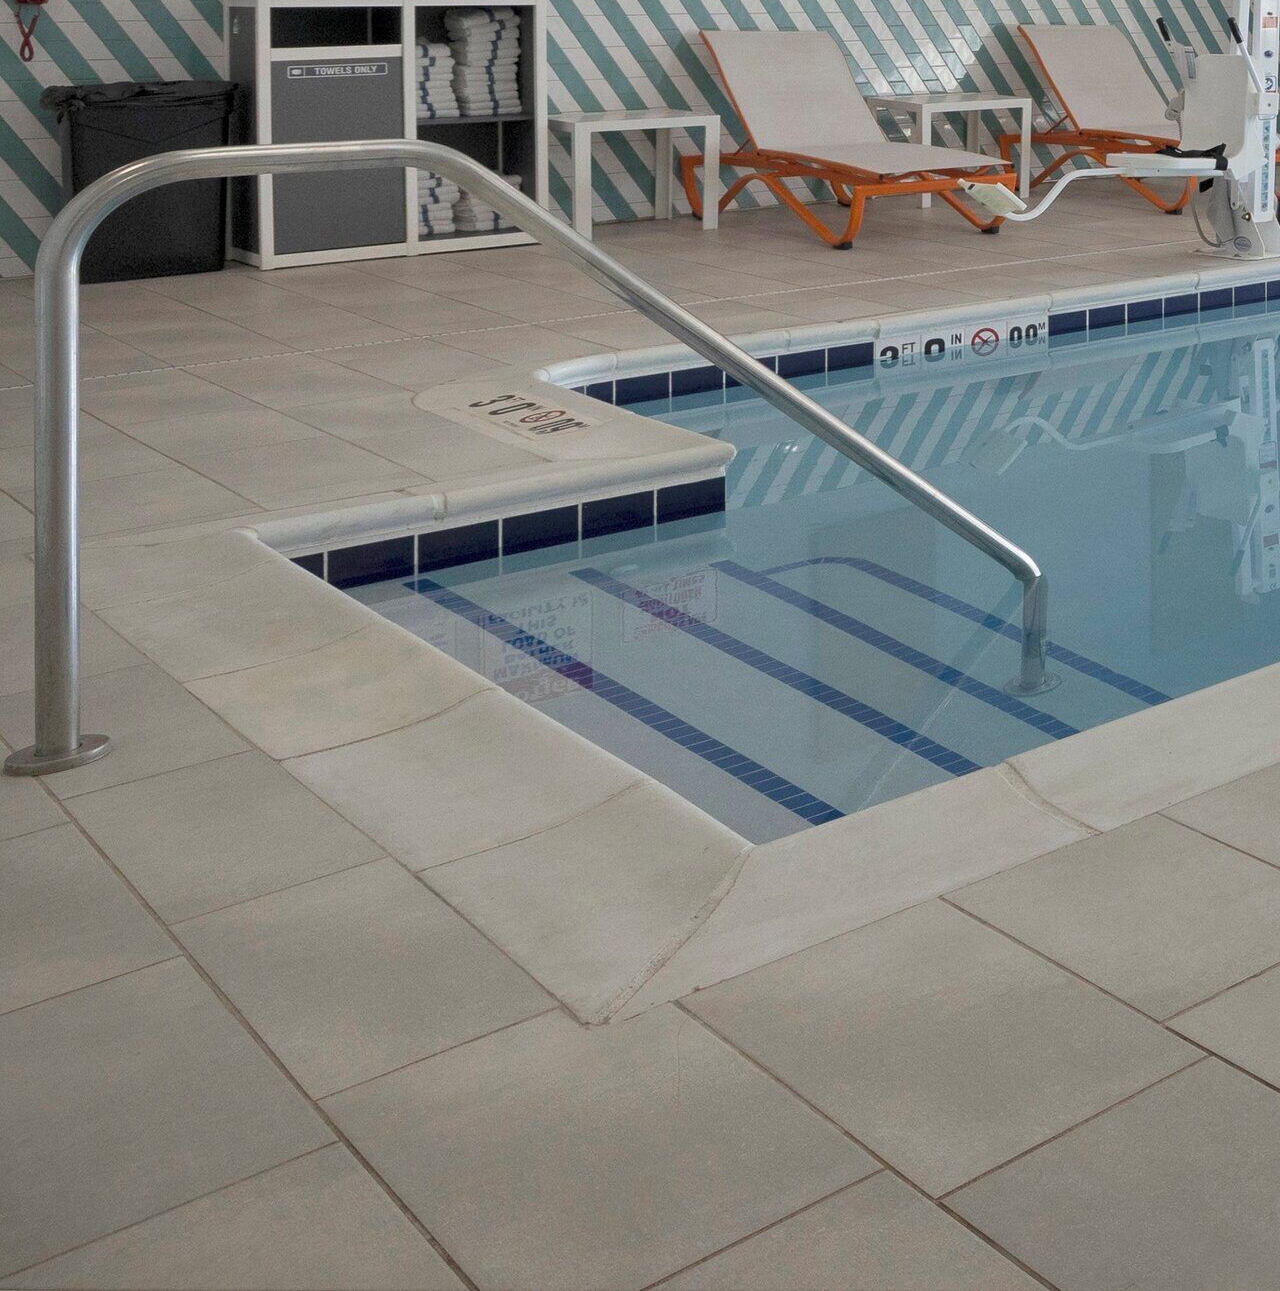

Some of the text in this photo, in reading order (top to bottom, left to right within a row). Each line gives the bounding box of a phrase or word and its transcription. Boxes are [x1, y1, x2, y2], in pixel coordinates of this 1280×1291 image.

[314, 65, 377, 75] TOWELS ONLY
[901, 341, 916, 354] FT
[951, 333, 962, 345] IN
[1038, 322, 1046, 330] M
[469, 394, 516, 408] 3
[488, 402, 537, 416] 0
